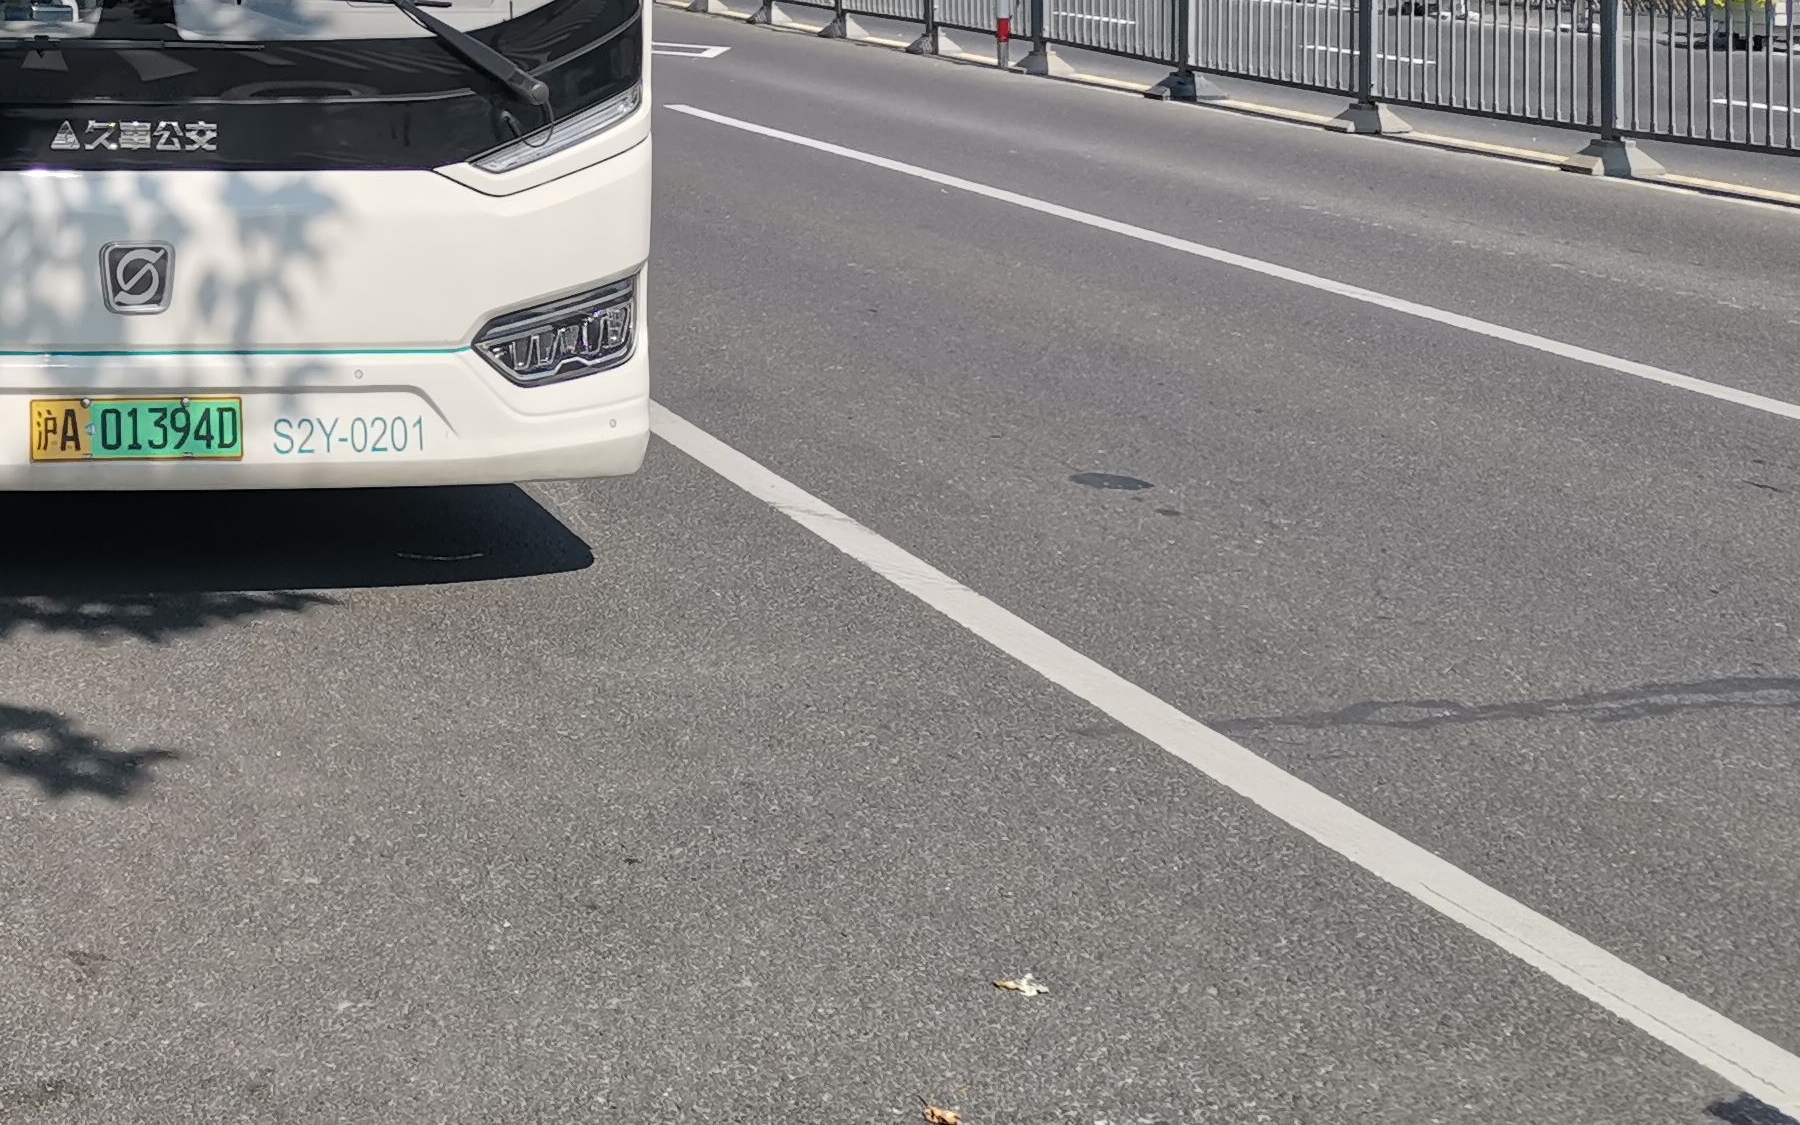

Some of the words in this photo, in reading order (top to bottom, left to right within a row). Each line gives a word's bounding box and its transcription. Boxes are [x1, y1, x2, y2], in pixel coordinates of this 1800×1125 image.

[84, 120, 218, 150] 久事公交
[273, 415, 424, 454] S2Y-0201
